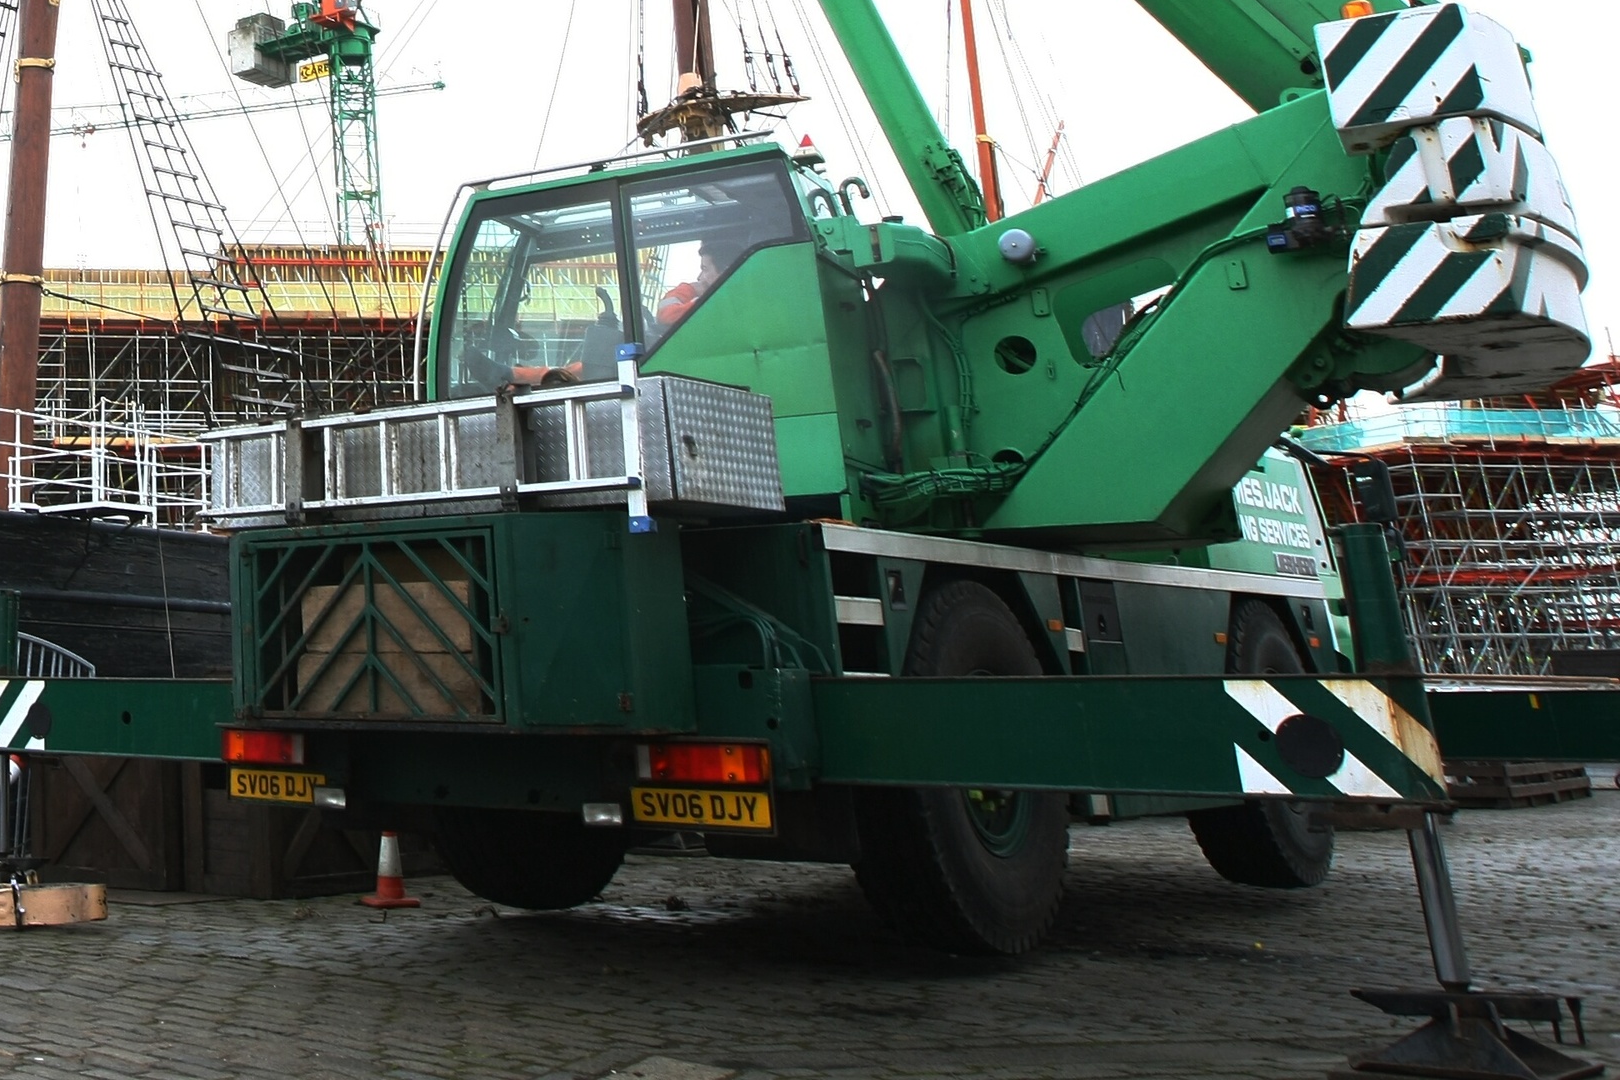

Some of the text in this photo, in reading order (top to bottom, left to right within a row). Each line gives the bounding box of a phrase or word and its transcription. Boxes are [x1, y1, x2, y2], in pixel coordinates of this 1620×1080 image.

[1264, 481, 1304, 515] JACK
[1258, 517, 1311, 549] SERVICES
[237, 774, 317, 800] SV06 DJY
[641, 792, 757, 822] SV06 DJY
